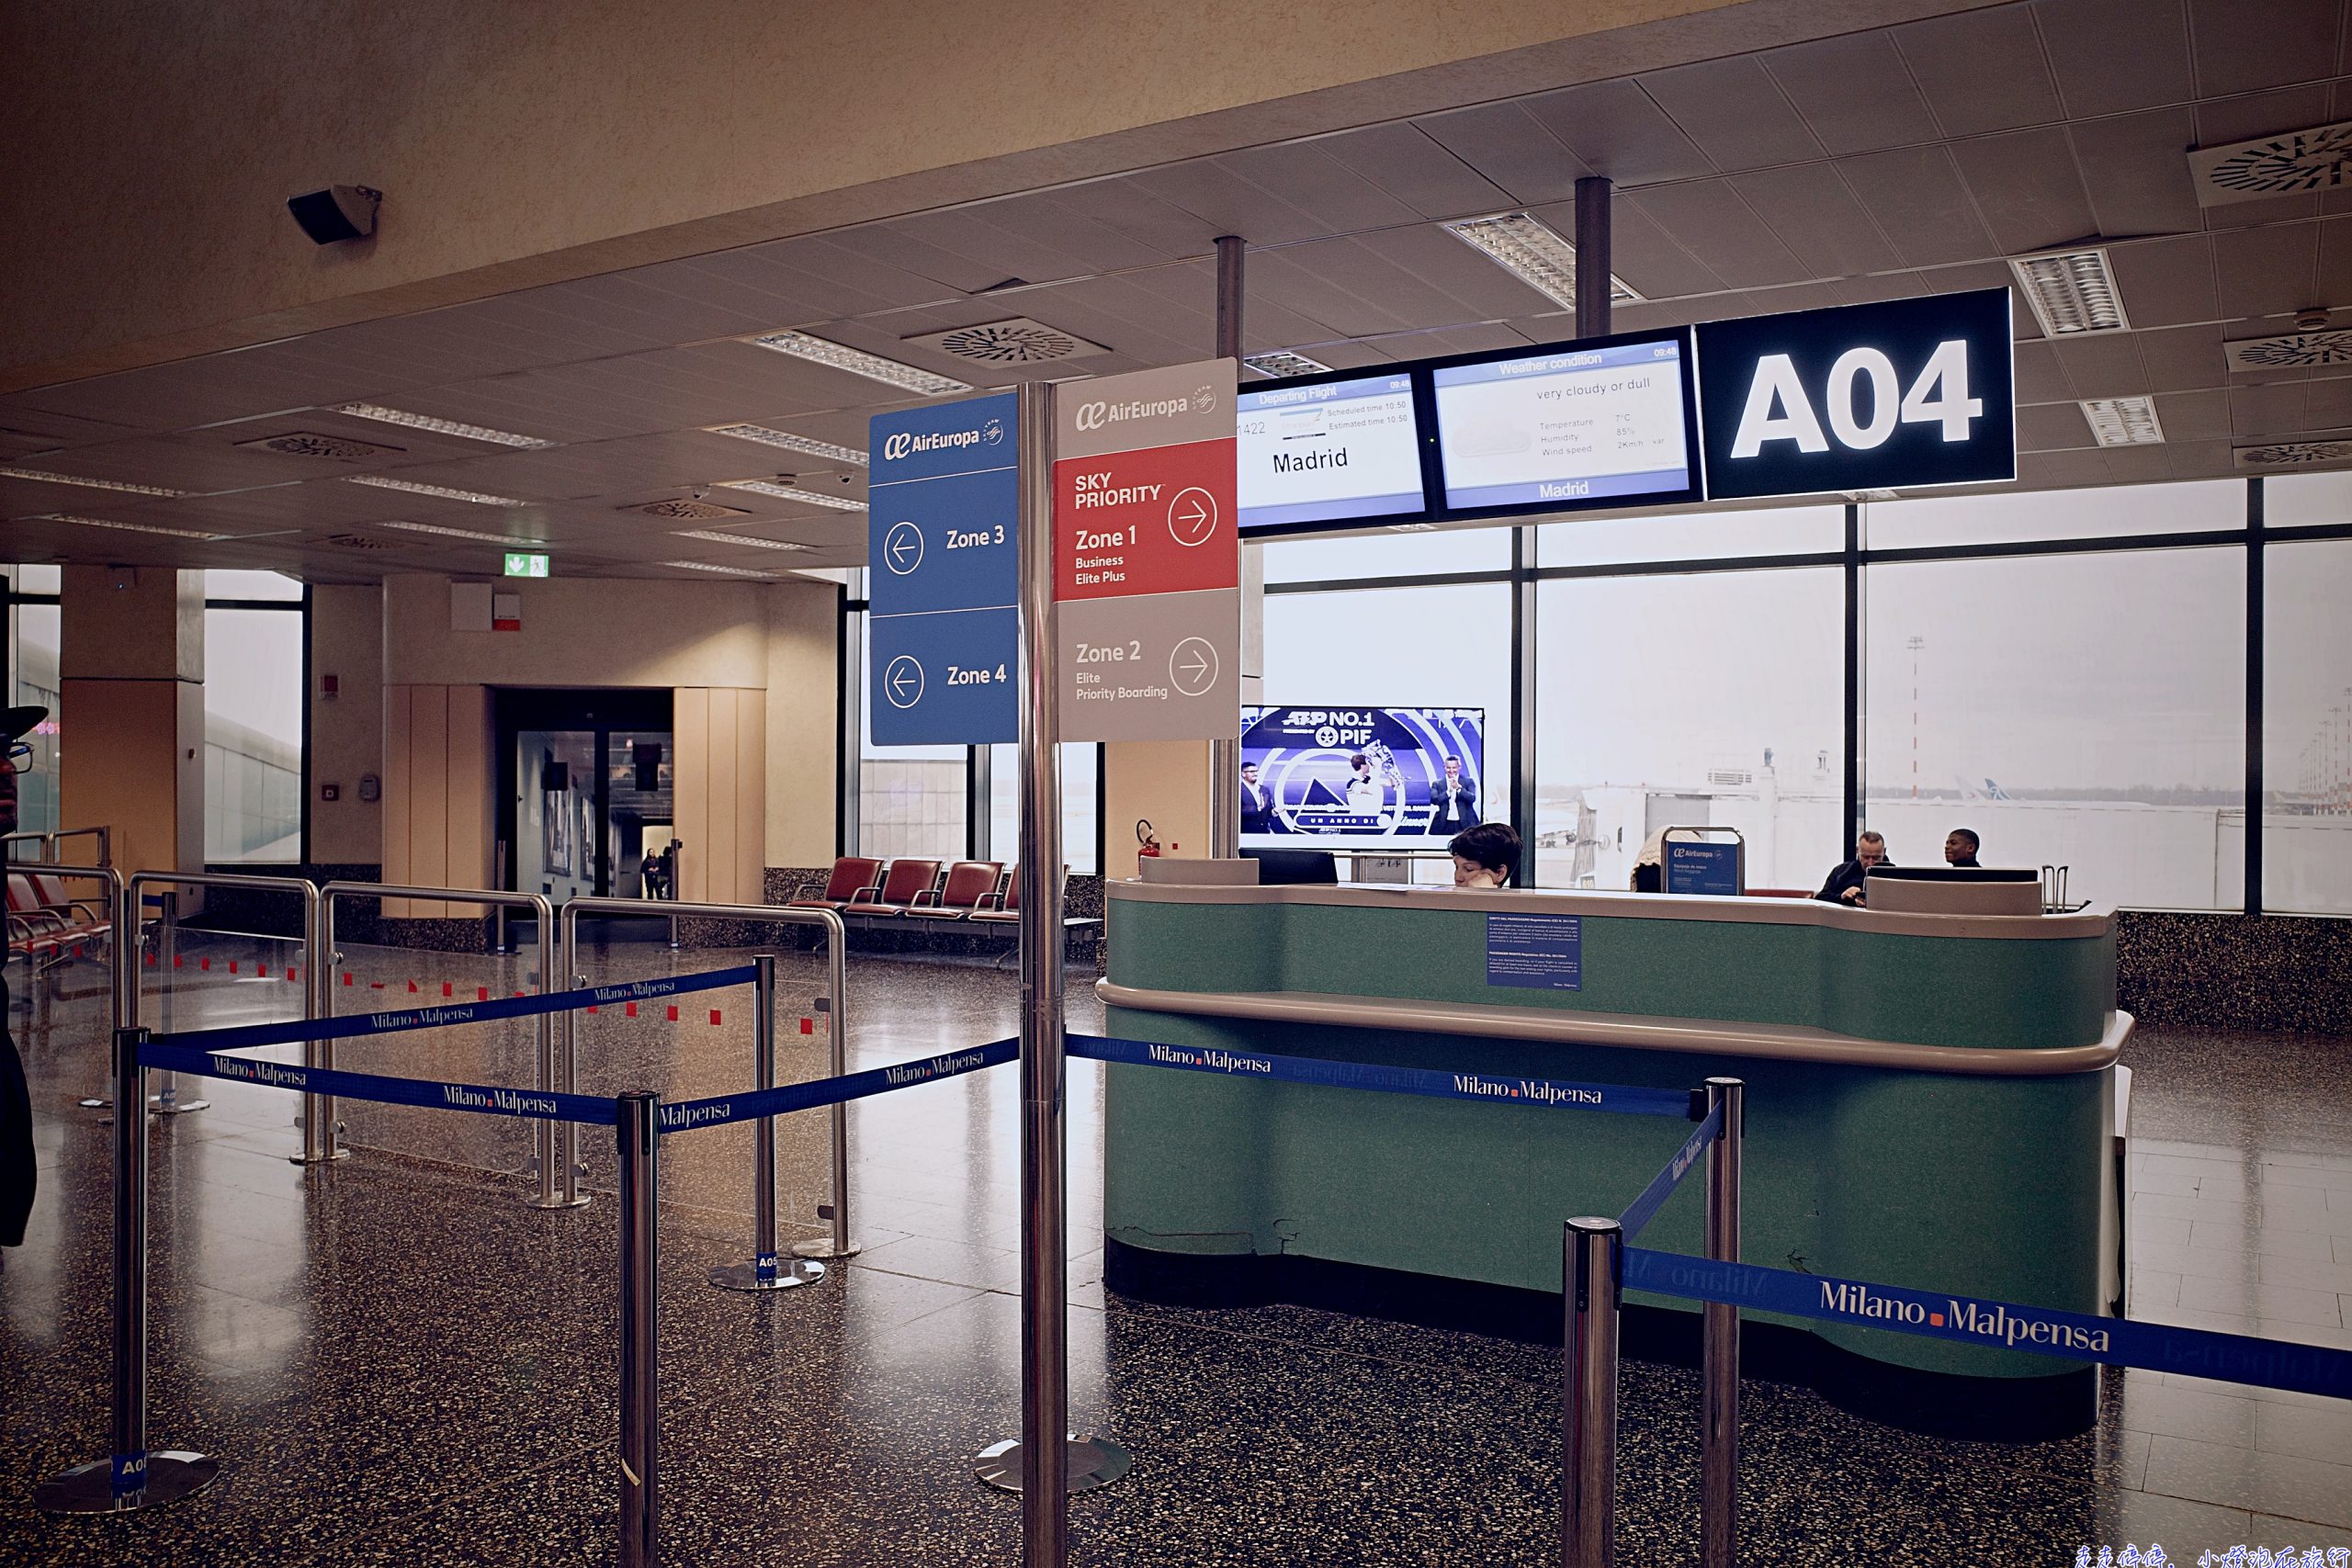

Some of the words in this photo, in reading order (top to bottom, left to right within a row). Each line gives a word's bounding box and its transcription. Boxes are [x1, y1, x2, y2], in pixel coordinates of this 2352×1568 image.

[1499, 357, 1548, 375] Weather
[1550, 352, 1601, 369] condition
[1259, 389, 1306, 405] Departing
[1308, 385, 1338, 400] Flight
[1536, 389, 1562, 401] very
[1566, 383, 1607, 398] cloudy
[1611, 381, 1623, 391] or
[1627, 378, 1651, 390] dull
[1730, 339, 1983, 461] A04
[1107, 397, 1188, 423] AirEuropa
[1327, 407, 1365, 417] Scheduled
[1367, 404, 1383, 412] time
[1385, 400, 1407, 410] 10:50
[1329, 420, 1366, 430] Estimated
[1367, 418, 1385, 426] time
[1387, 414, 1408, 423] 10:50
[1539, 418, 1594, 432] Temperature
[911, 428, 980, 454] AirEuropa
[1541, 433, 1579, 445] Humidity
[1273, 446, 1349, 474] Madrid
[1542, 447, 1564, 457] Wind
[1566, 446, 1592, 457] speed
[1075, 472, 1113, 492] SKY
[1539, 481, 1589, 498] Madrid
[1075, 484, 1161, 510] PRIORITY
[946, 528, 989, 550] Zone
[994, 525, 1005, 545] 3
[1076, 530, 1123, 551] Zone
[1128, 525, 1136, 545] 1
[1076, 555, 1124, 569] Business
[1076, 571, 1100, 585] Elite
[1102, 570, 1125, 584] Plus
[1076, 644, 1124, 664] Zone
[1129, 640, 1141, 660] 2
[947, 666, 990, 686] Zone
[994, 663, 1007, 682] 4
[1076, 672, 1101, 684] Elite
[1076, 687, 1116, 702] Priority
[1118, 685, 1168, 700] Boarding
[1329, 711, 1375, 727] NO.1
[1340, 728, 1373, 745] PIF
[594, 987, 627, 1001] Milano
[631, 979, 675, 998] Malpensa
[371, 1012, 412, 1029] Milano
[419, 1007, 473, 1026] Malpensa
[885, 1064, 925, 1087] Milano
[932, 1050, 984, 1076] Malpensa
[1148, 1044, 1194, 1065] Milano
[1203, 1050, 1272, 1074] Malpensa
[213, 1055, 248, 1077] Milano
[254, 1062, 306, 1087] Malpensa
[443, 1085, 486, 1109] Milano
[493, 1091, 557, 1116] Malpensa
[1453, 1074, 1509, 1098] Milano
[1519, 1079, 1603, 1104] Malpensa
[659, 1101, 730, 1130] Malpensa
[1820, 1280, 1926, 1325] Milano
[1947, 1298, 2109, 1355] Malpensa
